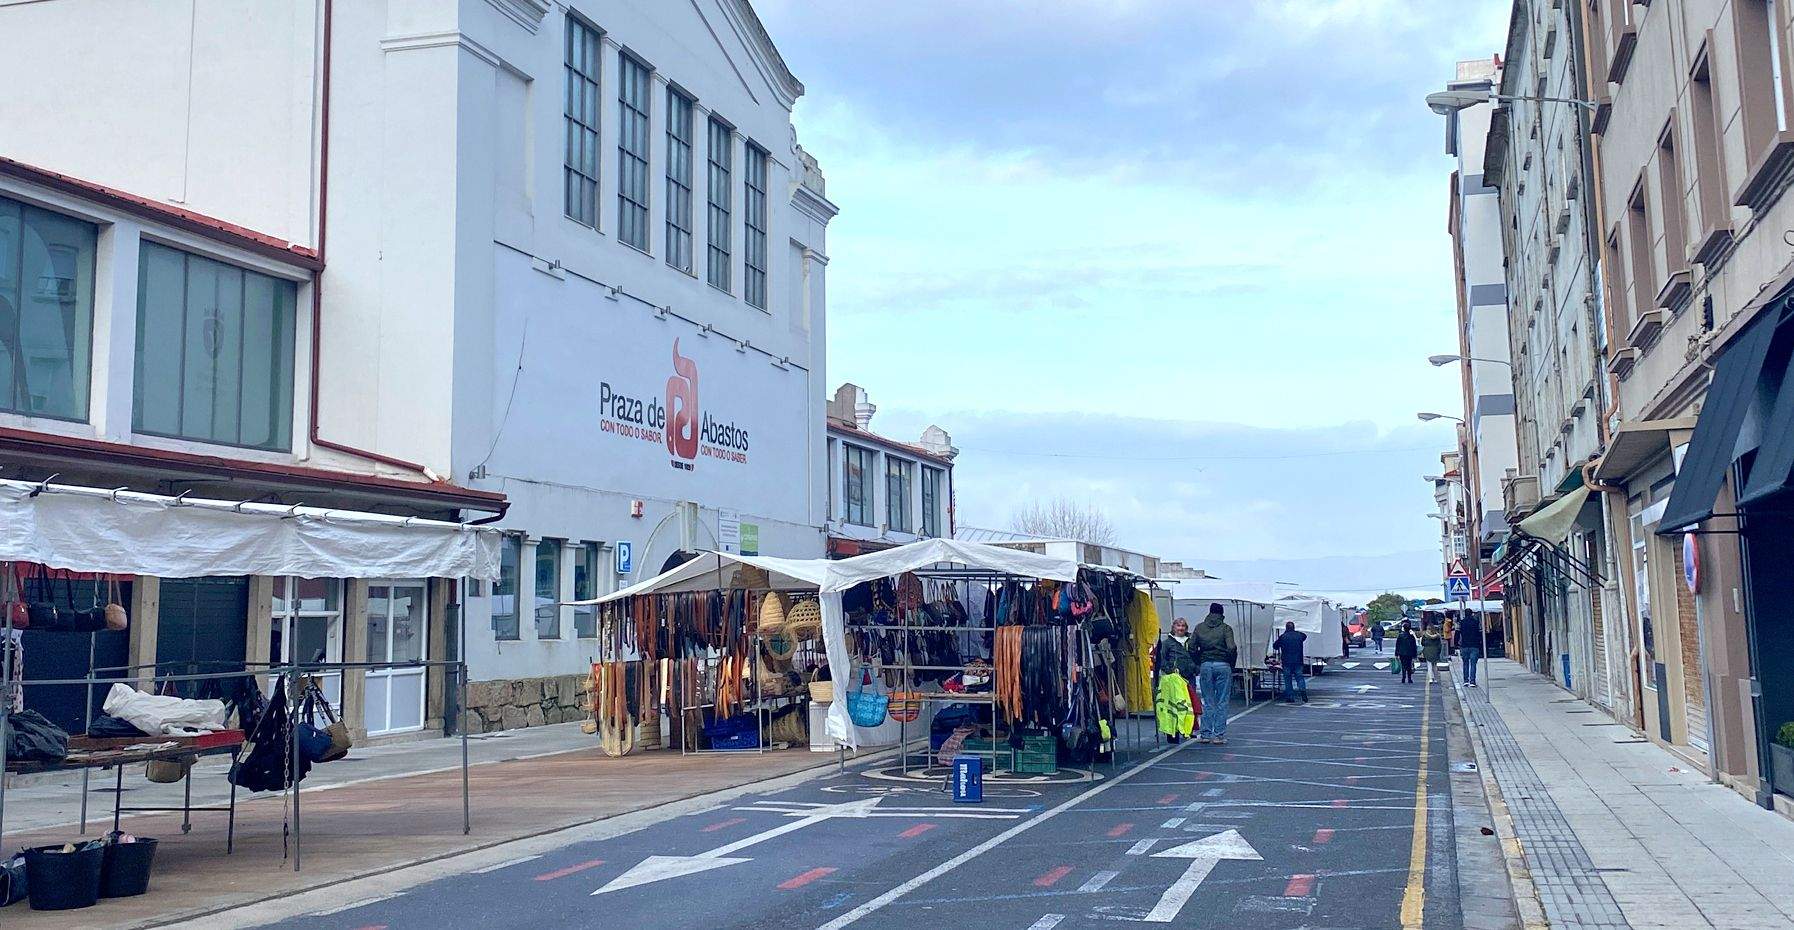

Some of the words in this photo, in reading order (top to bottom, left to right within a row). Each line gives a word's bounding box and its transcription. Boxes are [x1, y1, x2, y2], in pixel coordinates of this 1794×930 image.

[600, 382, 643, 425] Praza
[648, 397, 665, 429] de
[700, 411, 748, 451] Abastos
[600, 419, 614, 433] CON
[616, 423, 633, 437] TODO
[635, 427, 640, 439] O
[701, 444, 712, 456] CON
[712, 447, 726, 460] TODO
[727, 450, 731, 461] O
[620, 544, 629, 570] P
